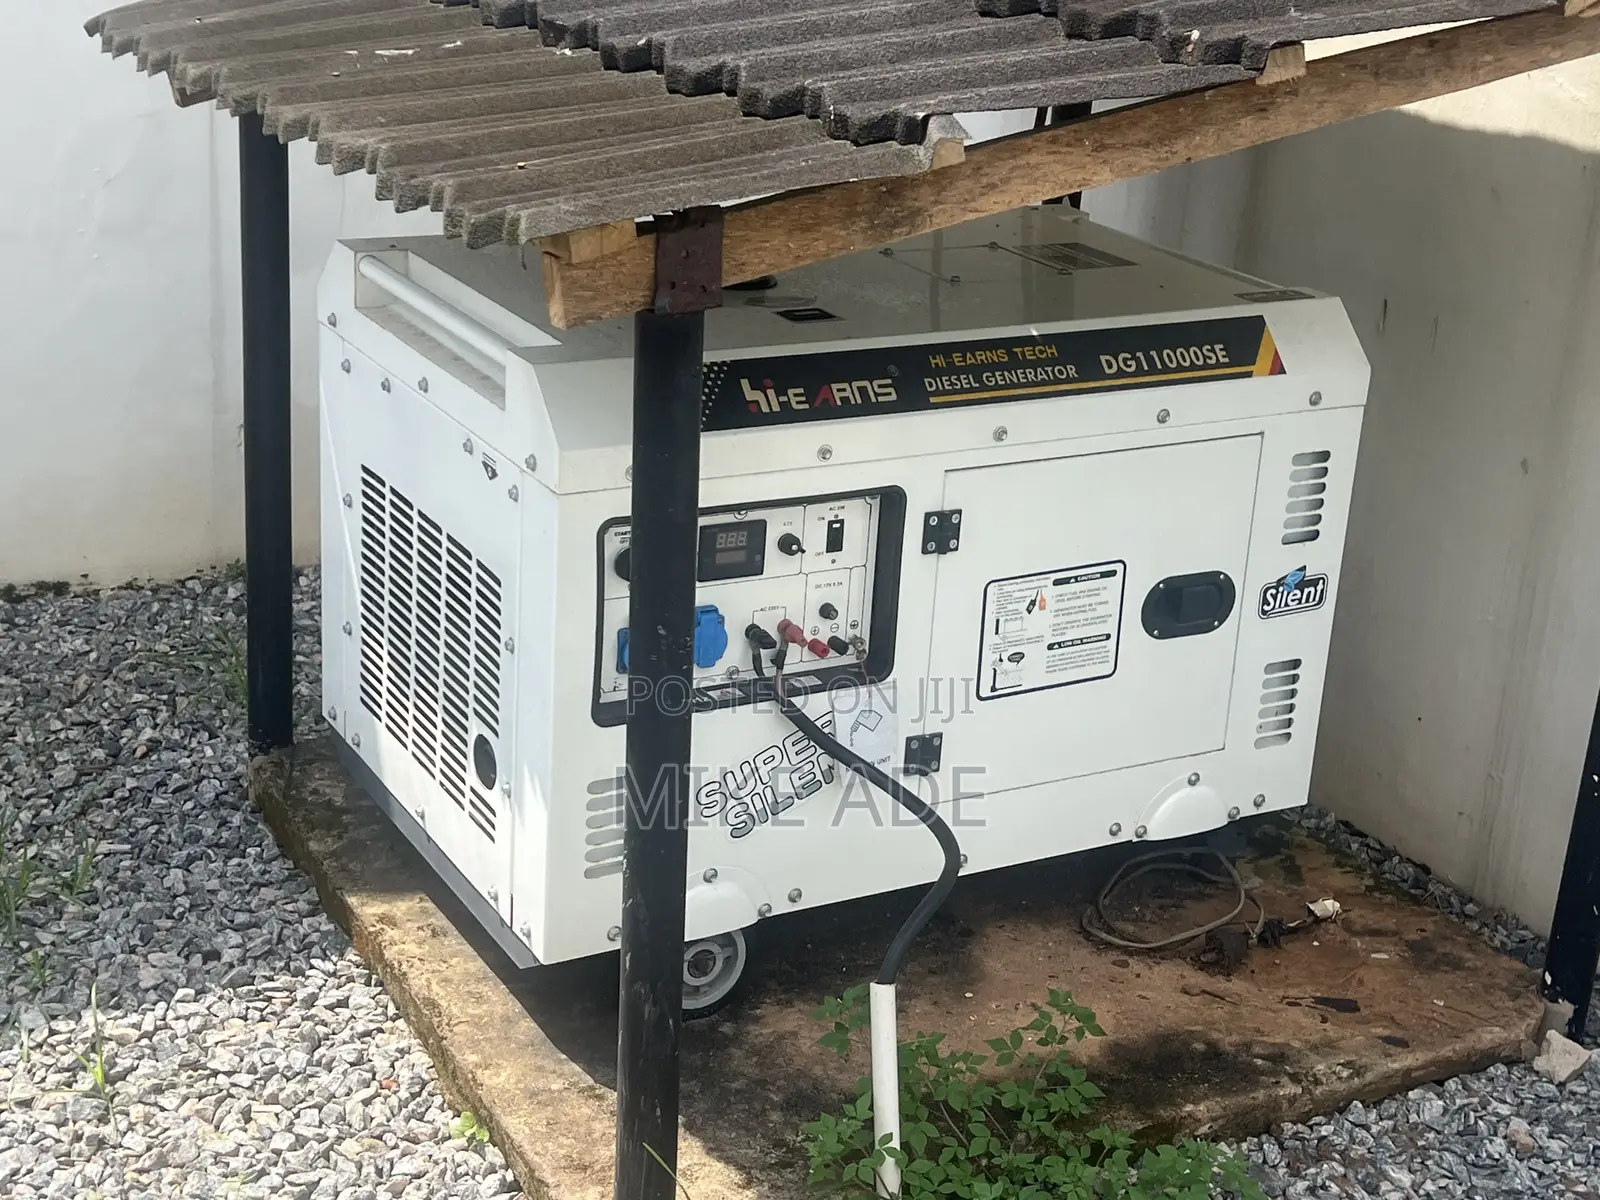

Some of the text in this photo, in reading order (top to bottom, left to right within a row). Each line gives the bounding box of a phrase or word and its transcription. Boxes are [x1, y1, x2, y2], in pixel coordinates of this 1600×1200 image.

[928, 344, 1059, 369] HI-EARNS TECH
[1099, 344, 1230, 375] DG11000SE
[923, 364, 1079, 392] DIESEL GENERATOR
[1262, 579, 1324, 611] Silent
